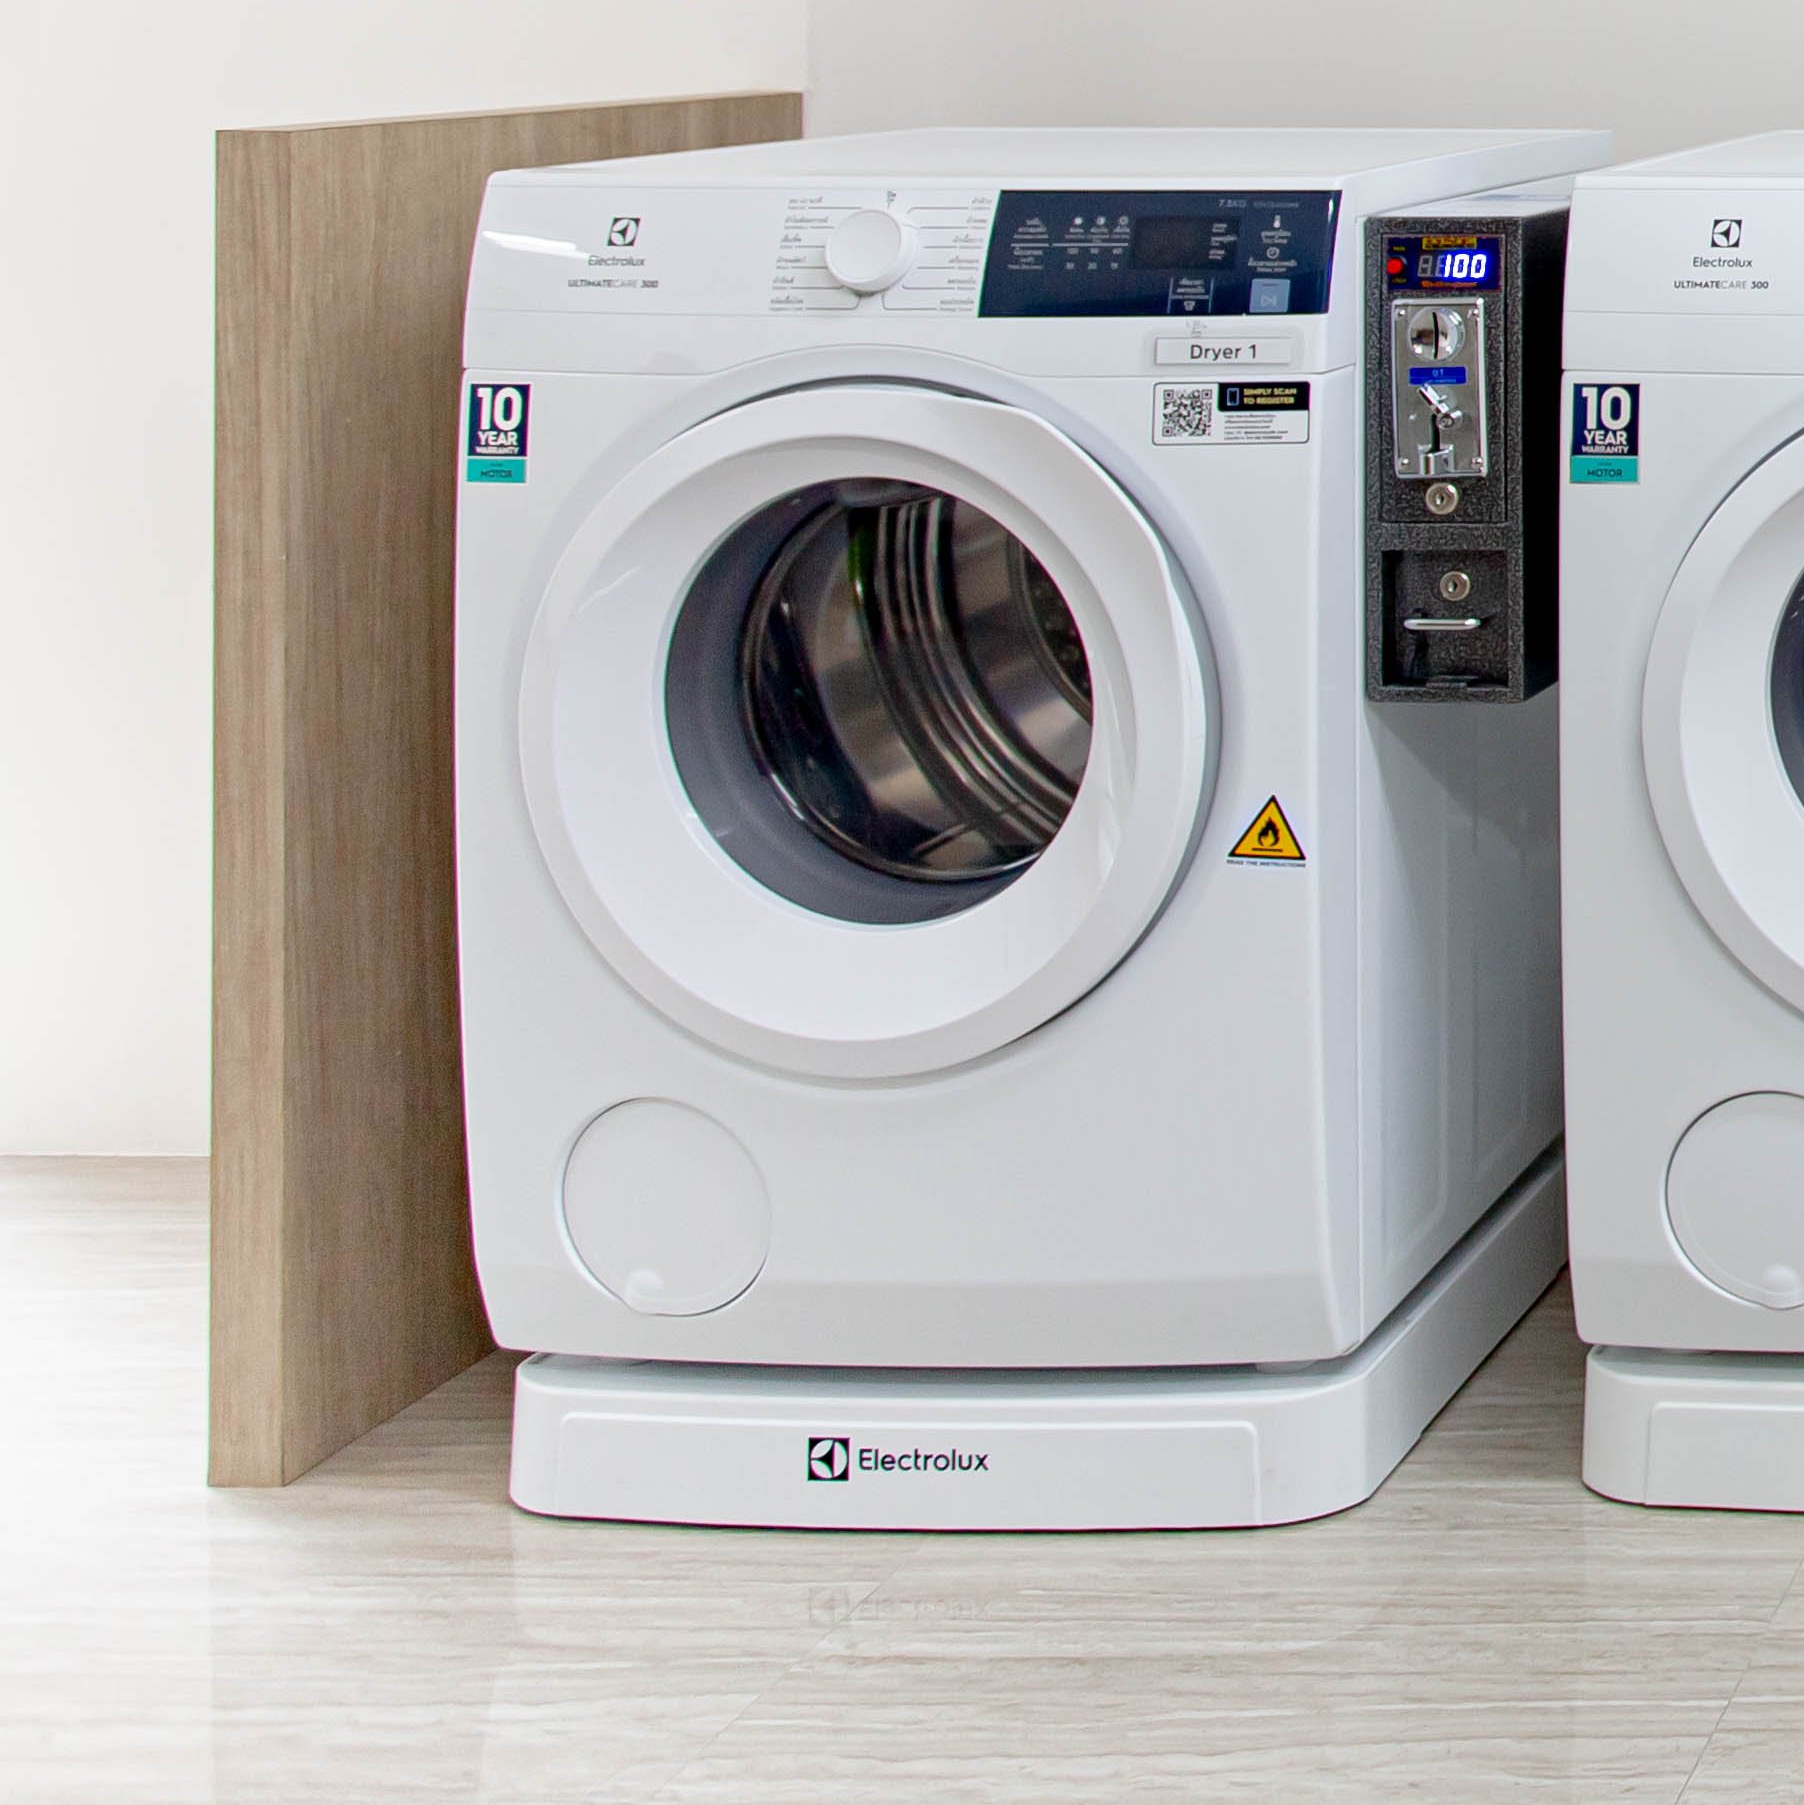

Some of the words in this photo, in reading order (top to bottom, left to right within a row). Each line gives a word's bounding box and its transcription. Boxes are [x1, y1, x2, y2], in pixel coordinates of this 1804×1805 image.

[588, 254, 646, 266] Electrolux
[1444, 253, 1487, 278] 100
[1692, 256, 1752, 268] Electrolux
[1674, 280, 1746, 289] ULTIMATECARE
[1190, 344, 1241, 361] Dryer
[1249, 344, 1257, 358] 1
[1244, 388, 1272, 396] SIMPLY
[1273, 387, 1298, 396] SCAN
[1243, 397, 1254, 405] TO
[1256, 396, 1295, 405] REGISTER
[477, 387, 523, 431] 10
[1582, 386, 1631, 430] 10
[478, 431, 518, 446] YEAR
[1584, 430, 1628, 445] YEAR
[1582, 445, 1629, 454] WARRANTY
[1587, 469, 1623, 478] MOTOR
[858, 1448, 989, 1471] Electrolux
